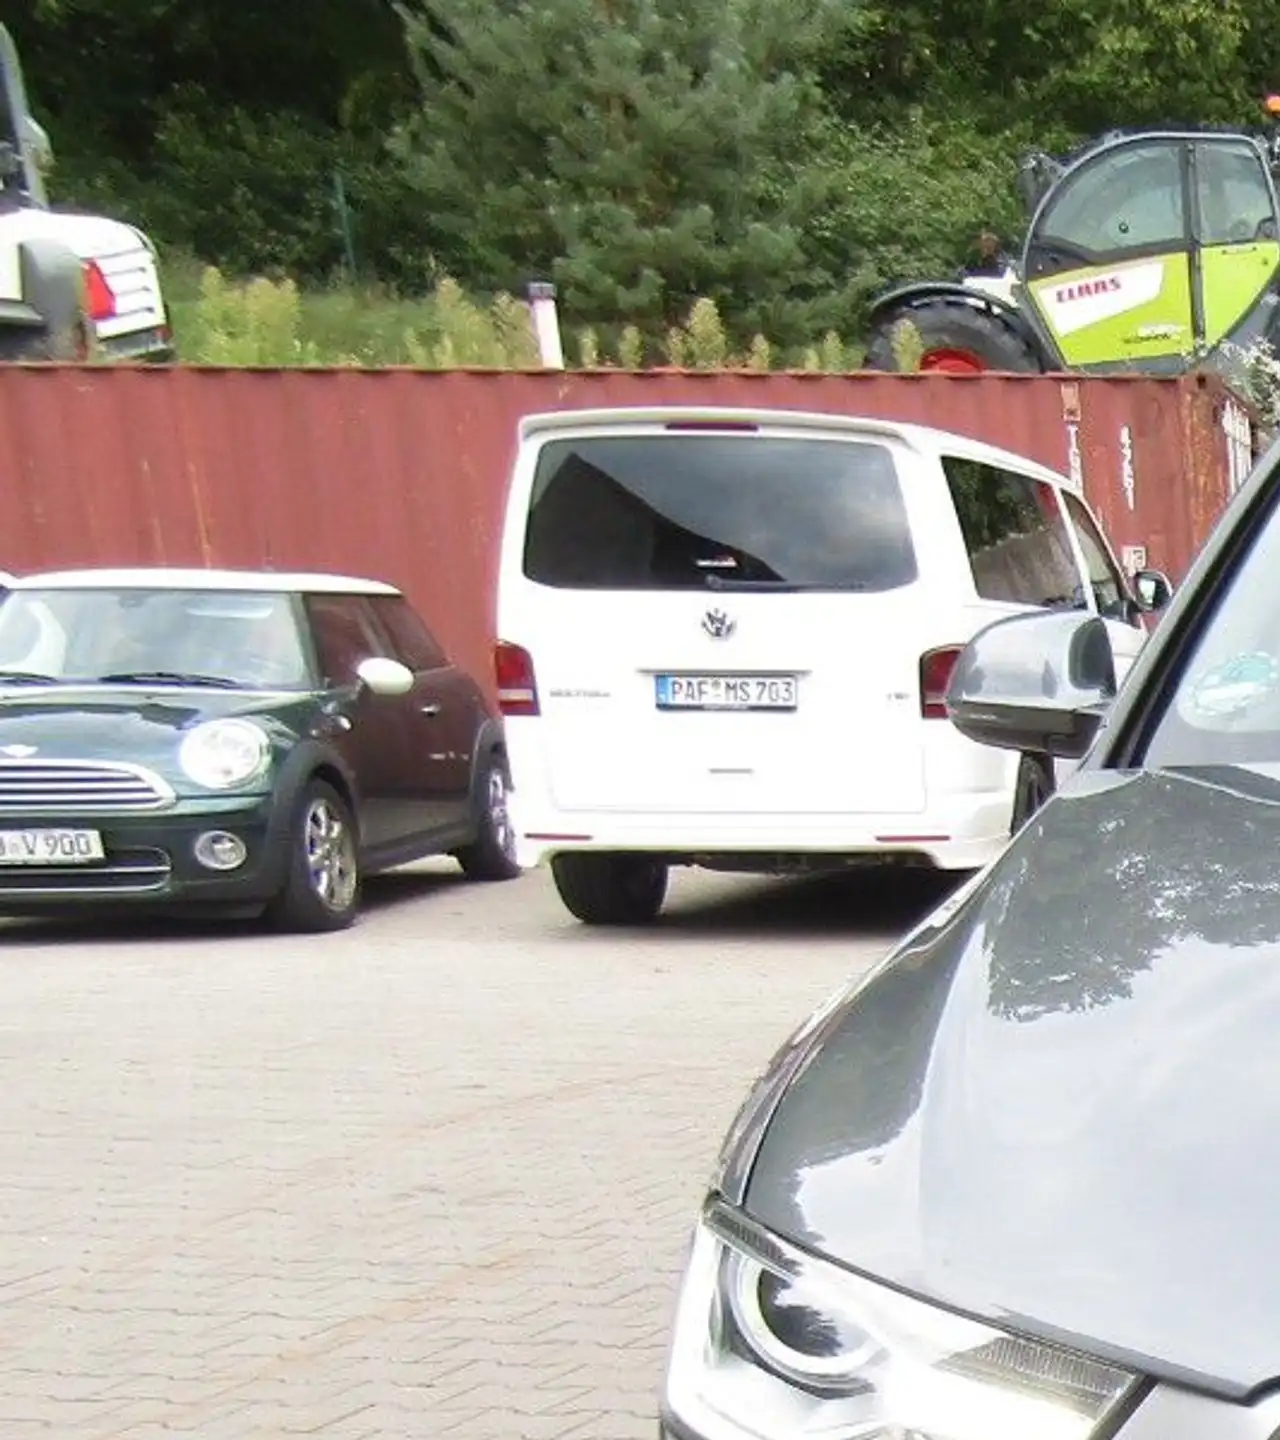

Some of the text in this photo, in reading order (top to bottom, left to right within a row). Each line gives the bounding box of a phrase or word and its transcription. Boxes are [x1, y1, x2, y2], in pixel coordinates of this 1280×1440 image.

[1055, 275, 1122, 304] CLAAS
[671, 680, 793, 702] PAF MS 703
